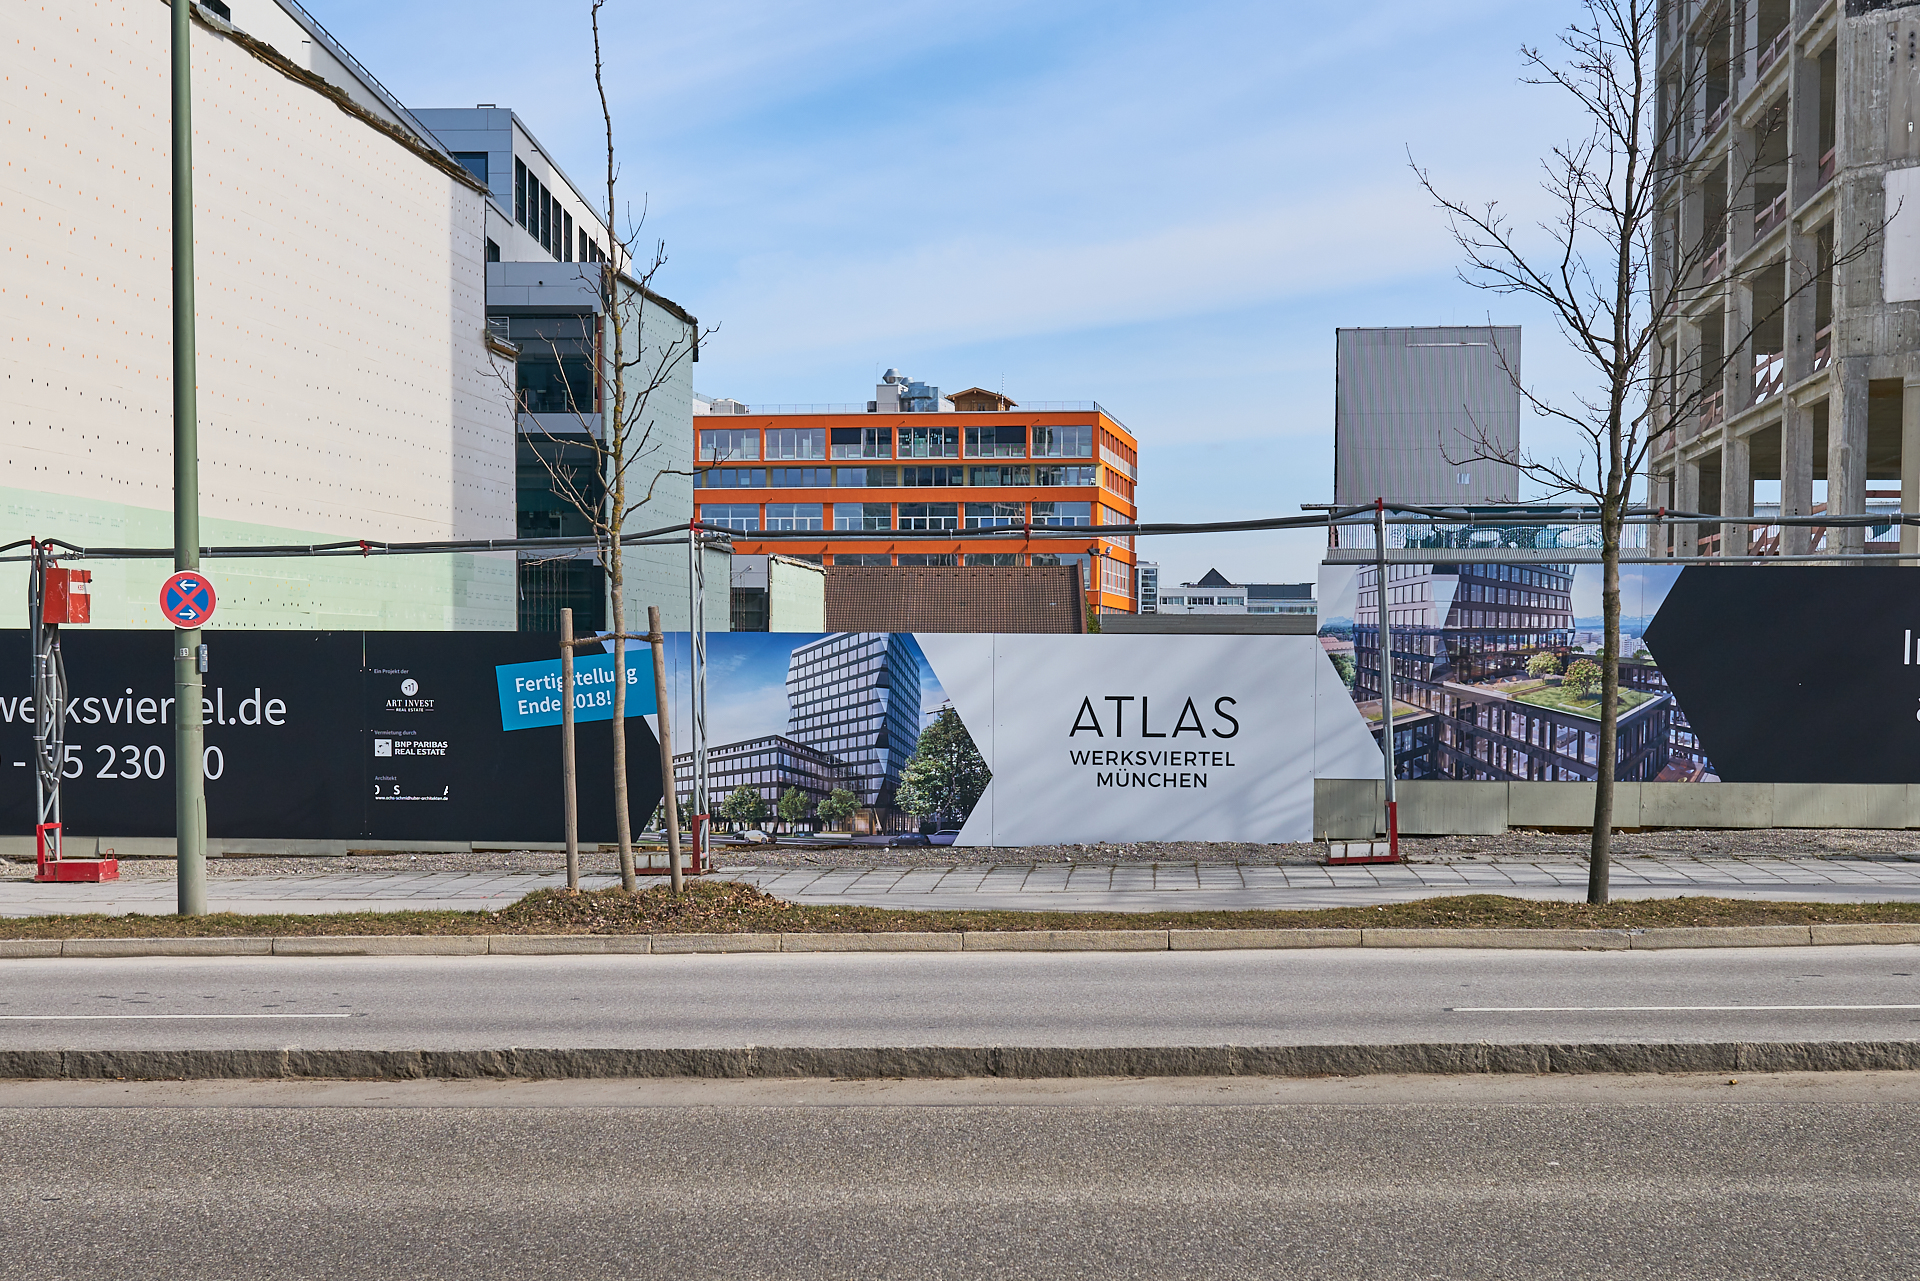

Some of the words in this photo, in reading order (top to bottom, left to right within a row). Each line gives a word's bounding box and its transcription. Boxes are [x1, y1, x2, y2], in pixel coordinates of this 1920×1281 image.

[515, 668, 638, 693] Fertigtellug
[386, 699, 403, 707] ART
[404, 699, 435, 708] INVEST
[517, 695, 561, 715] Ende
[568, 689, 612, 710] 018!
[1069, 695, 1239, 739] ATLAS
[96, 744, 166, 780] 230
[394, 748, 415, 756] REAL
[416, 748, 446, 756] ESTATE
[1069, 750, 1236, 767] WERKSVIERTEL
[1096, 768, 1208, 788] MÜNCHEN
